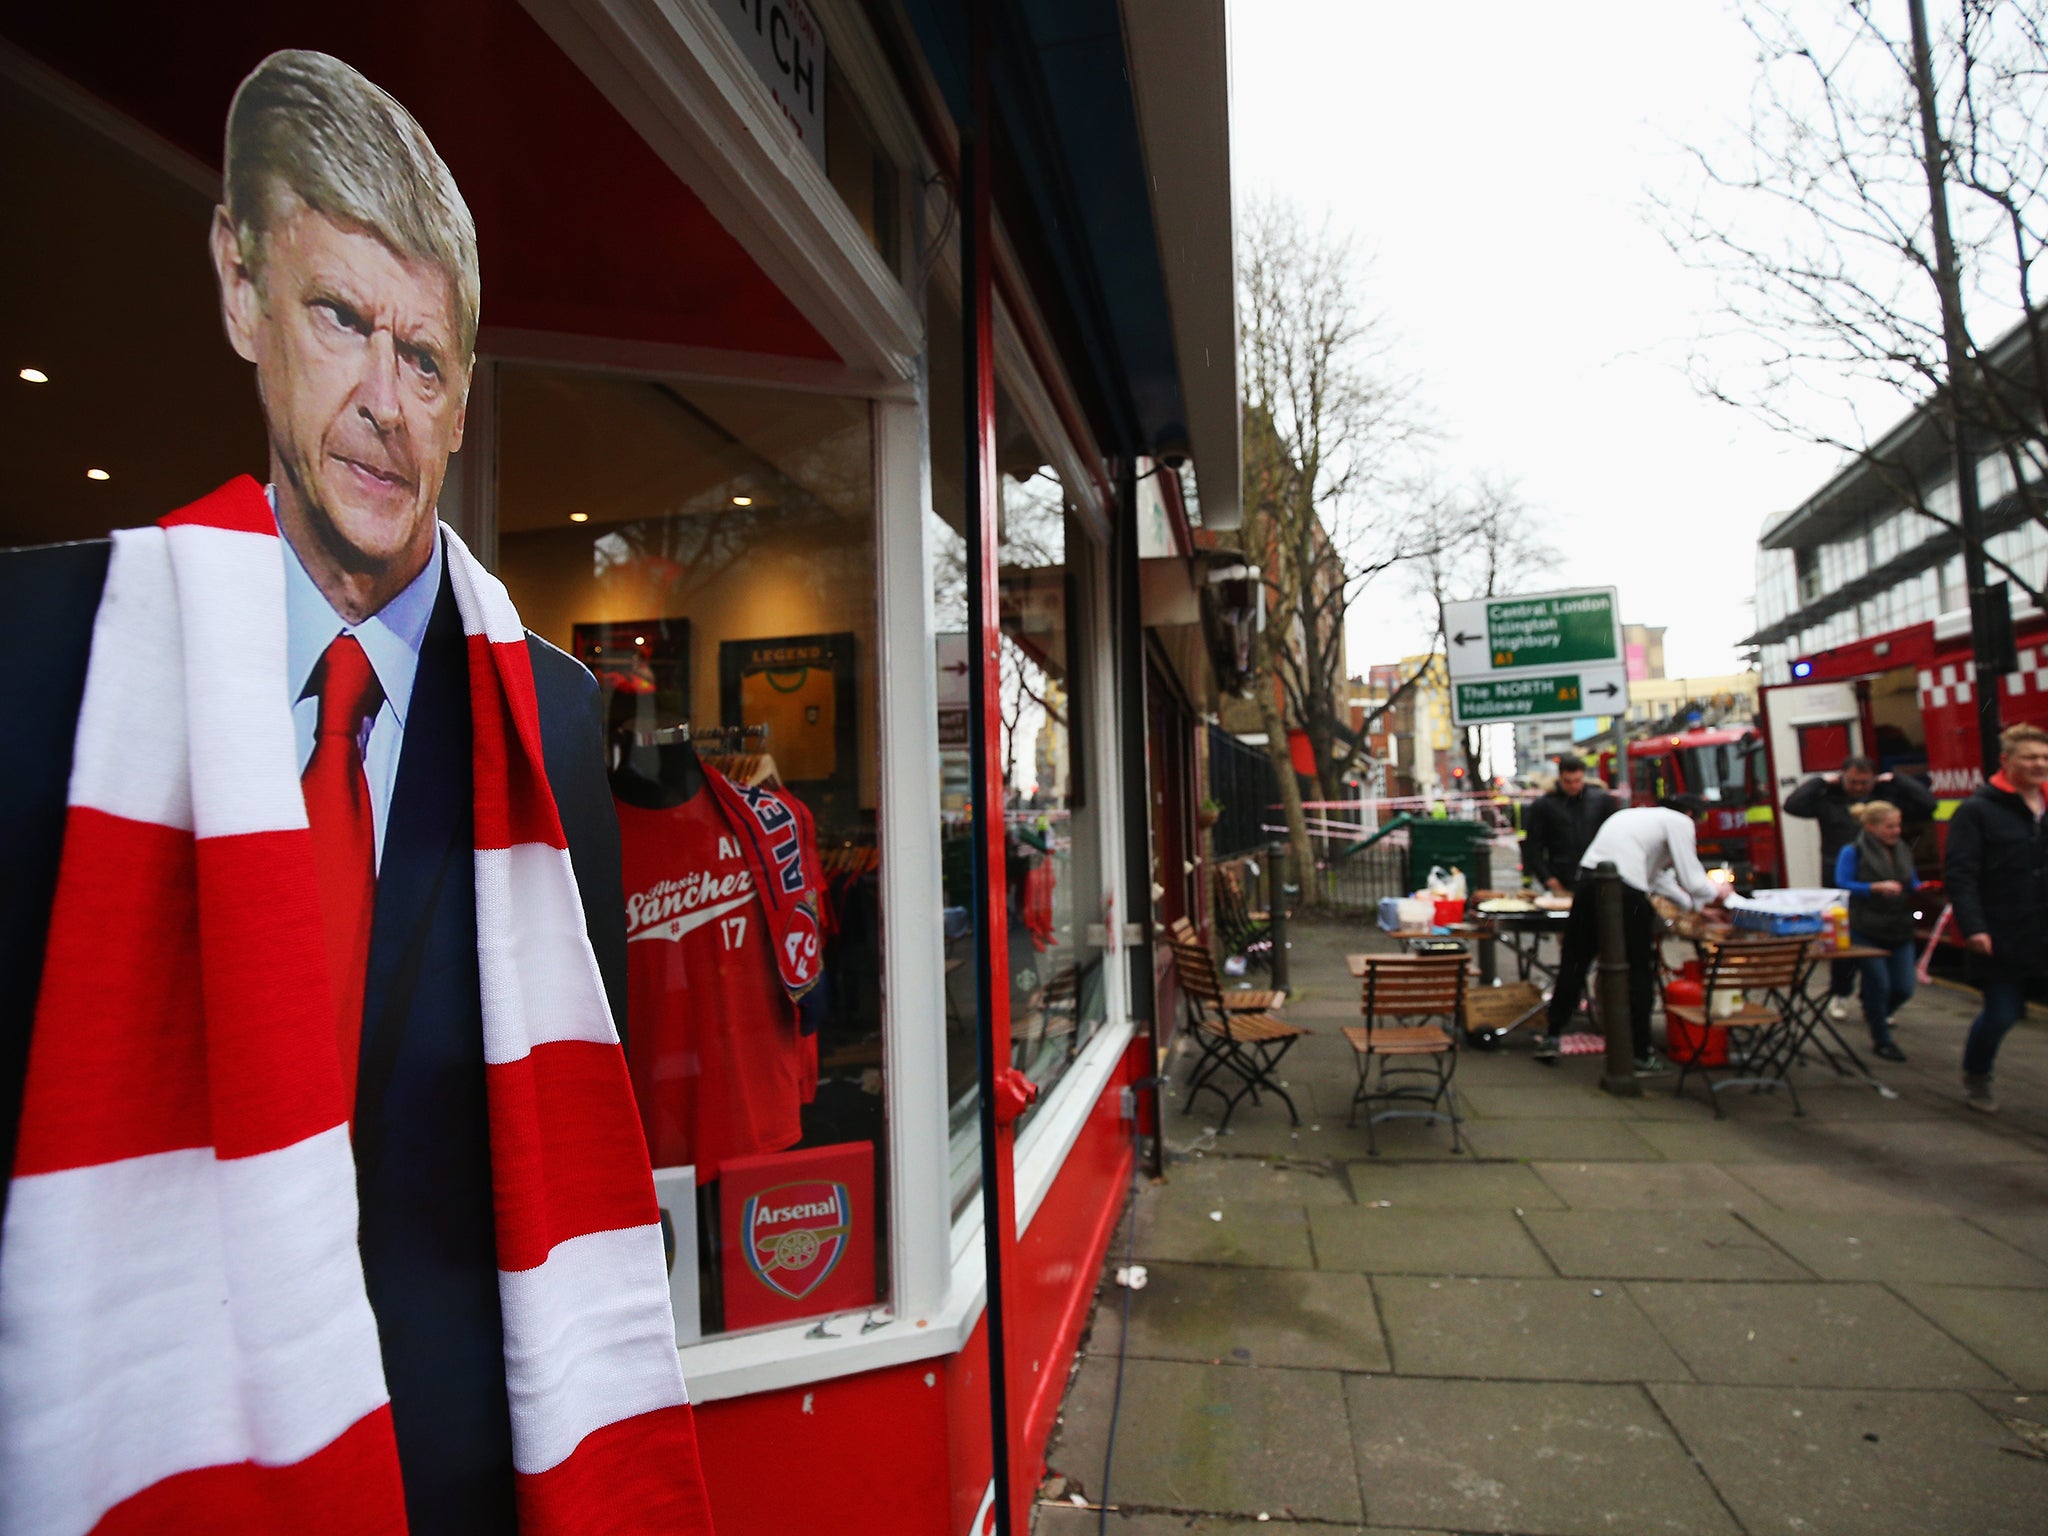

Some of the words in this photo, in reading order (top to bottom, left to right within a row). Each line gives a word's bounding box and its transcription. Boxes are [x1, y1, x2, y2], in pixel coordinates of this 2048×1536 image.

[1491, 604, 1546, 620] Central
[1554, 597, 1610, 613] London
[1492, 618, 1557, 635] Islington
[1493, 633, 1561, 651] Highbury
[753, 647, 820, 662] LEGEND
[1494, 651, 1513, 665] A1
[1463, 685, 1489, 699] The
[1497, 681, 1554, 695] NORTH
[1557, 687, 1578, 701] A1
[1463, 699, 1534, 717] Holloway
[644, 871, 701, 901] Alexis
[626, 870, 753, 933] Sanchez
[721, 916, 748, 951] 17
[755, 1195, 836, 1225] Arsenal
